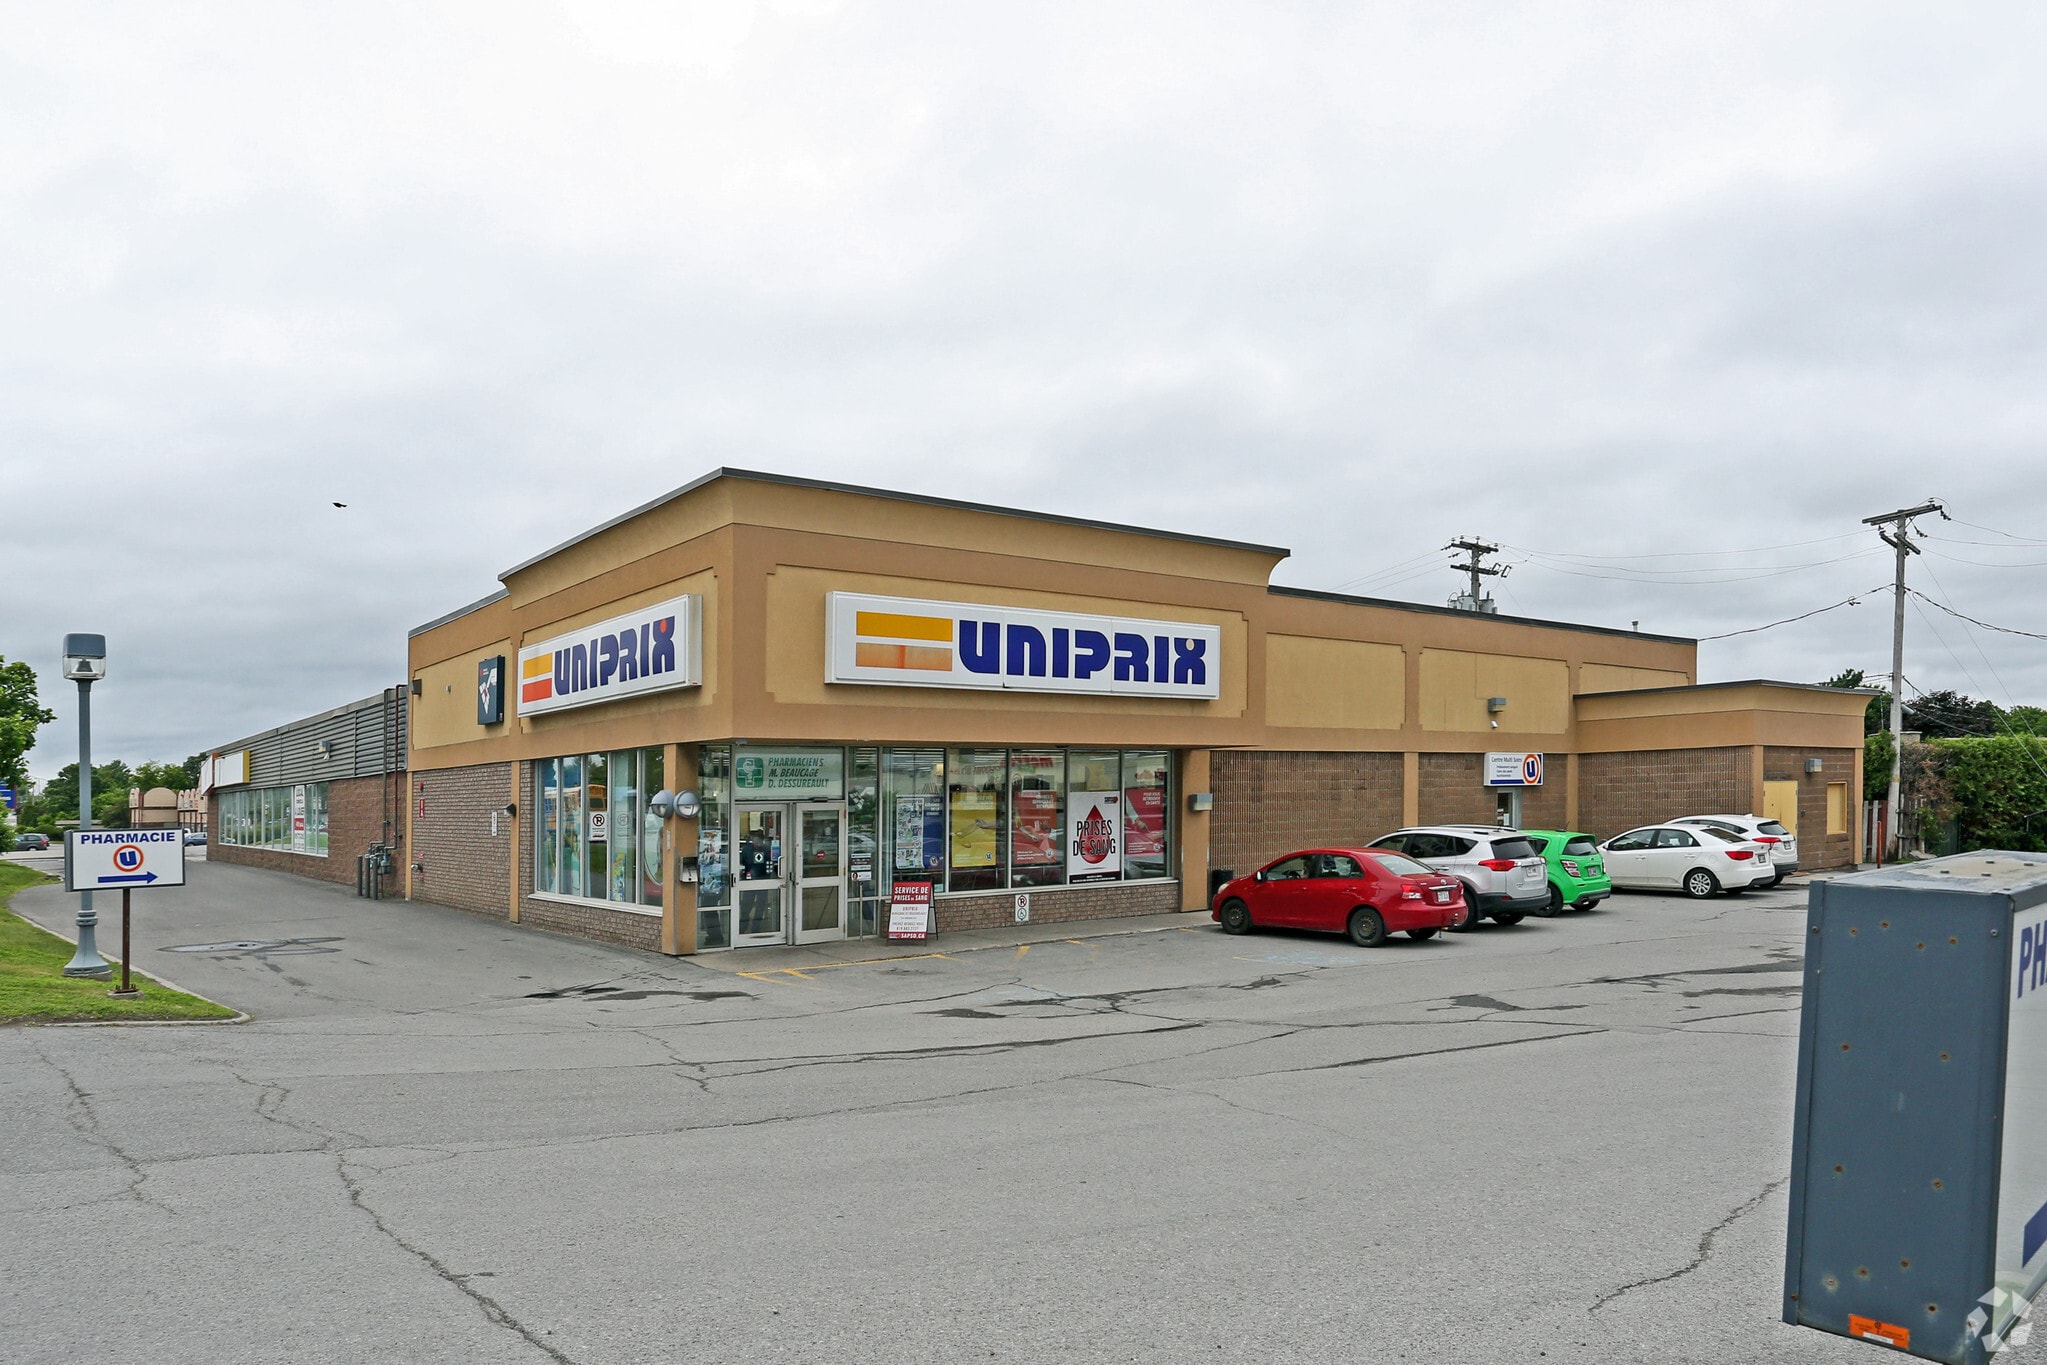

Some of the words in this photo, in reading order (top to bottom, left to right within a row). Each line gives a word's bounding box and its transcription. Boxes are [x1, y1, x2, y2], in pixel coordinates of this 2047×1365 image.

[554, 615, 675, 696] UNIPRIX
[959, 620, 1206, 685] UNIPRIX
[768, 757, 824, 767] PHARMACIENS
[769, 768, 778, 777] M.
[780, 768, 819, 777] BEAUCAGE
[768, 779, 776, 788] D.
[778, 778, 829, 788] DESSUREAULT
[1077, 820, 1112, 837] PRISES
[80, 832, 175, 844] PHARMACIE
[1073, 840, 1086, 856] DE
[1090, 838, 1116, 856] SANG
[894, 886, 919, 894] SERVICE
[920, 886, 929, 894] DE
[2017, 918, 2047, 999] PH
